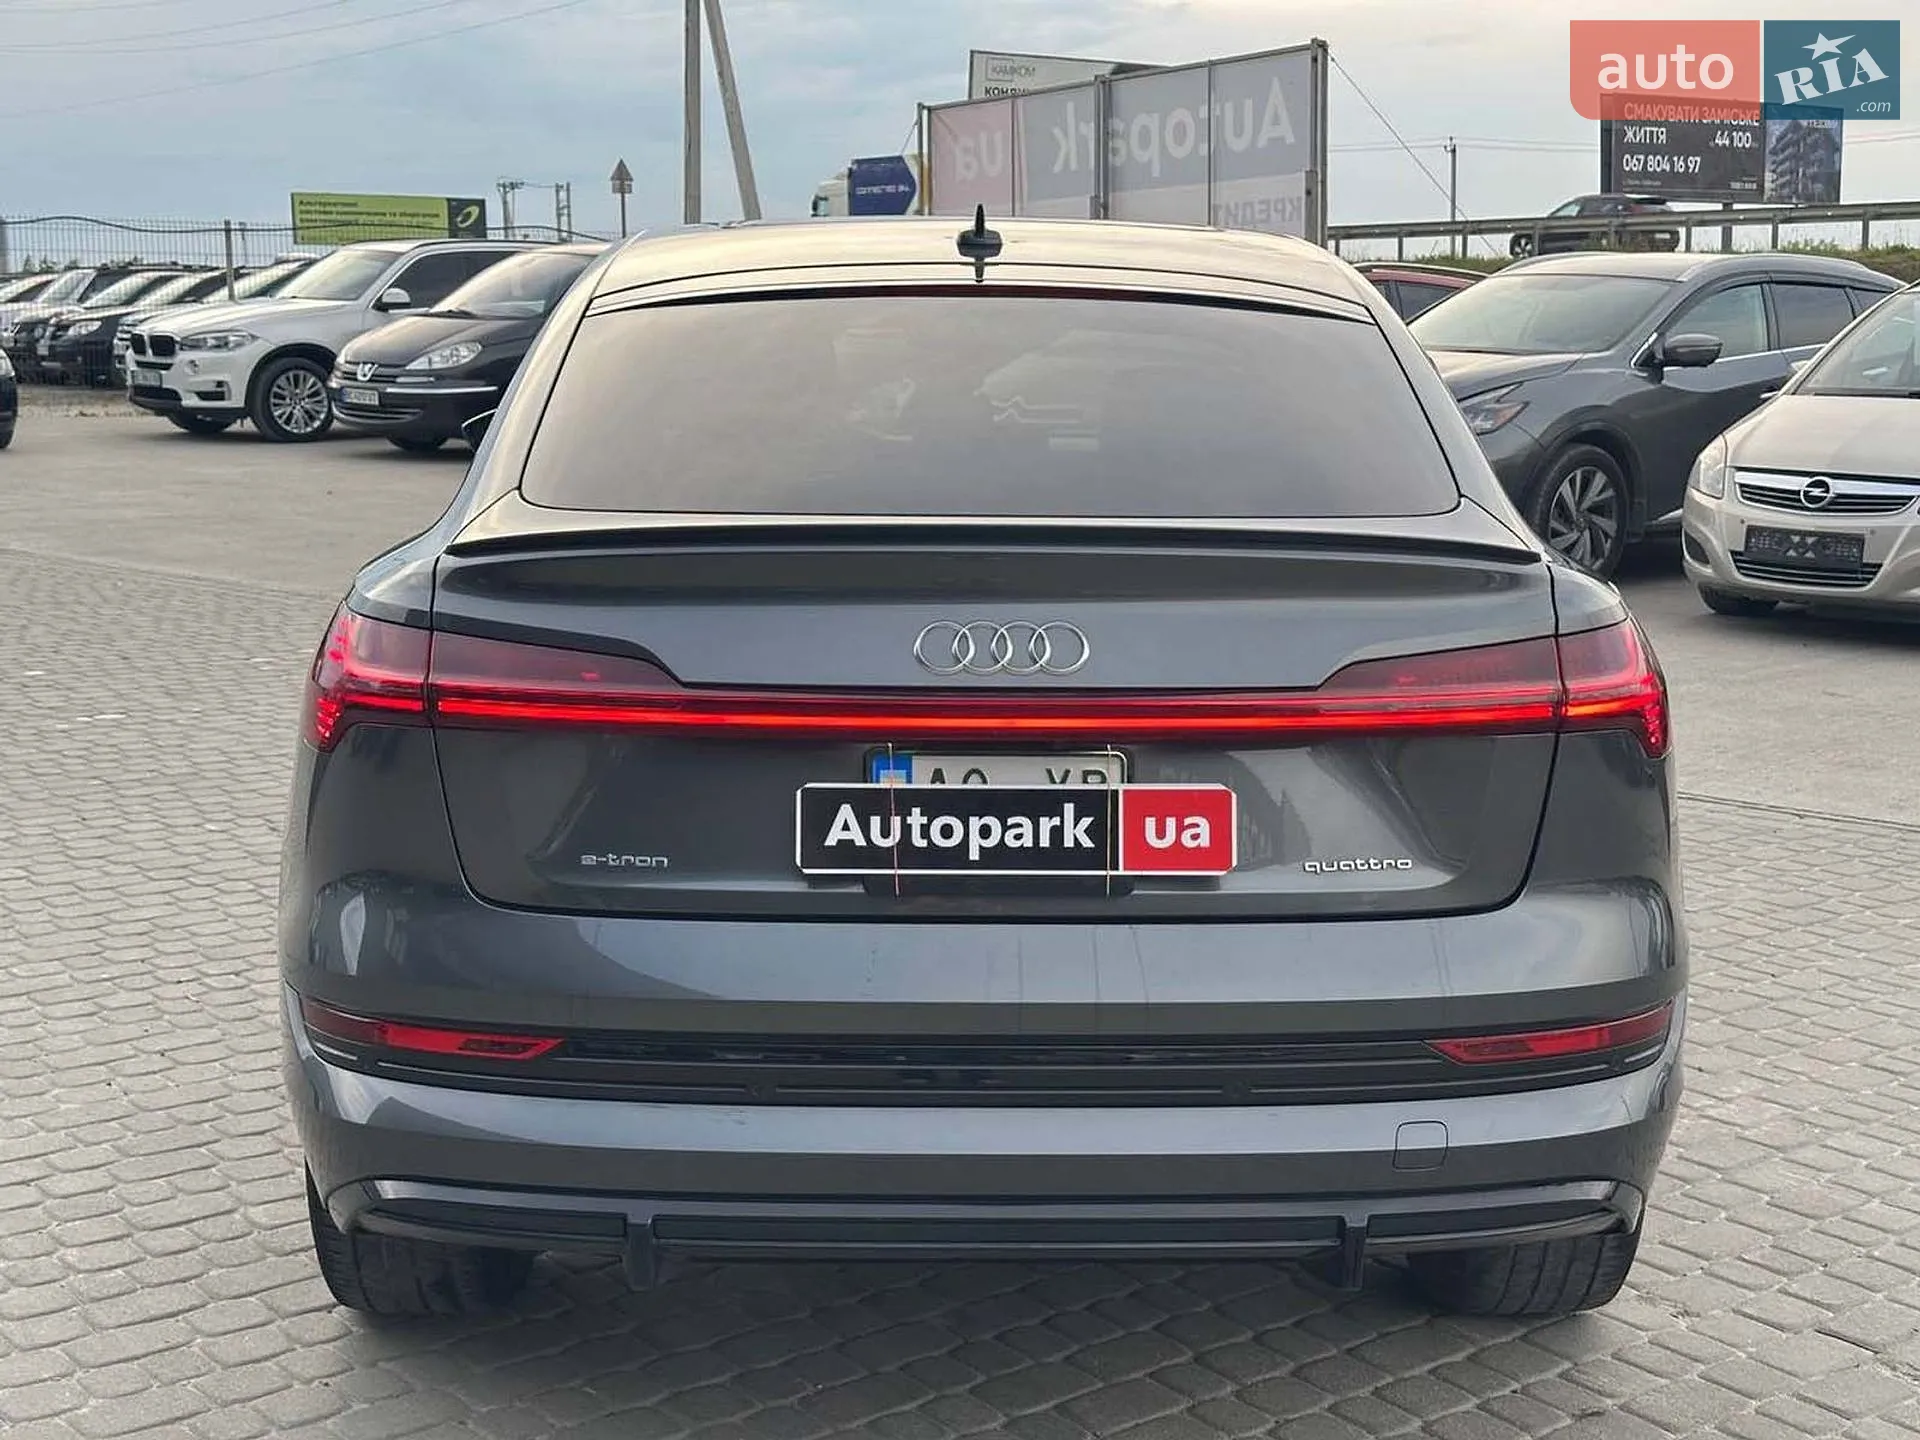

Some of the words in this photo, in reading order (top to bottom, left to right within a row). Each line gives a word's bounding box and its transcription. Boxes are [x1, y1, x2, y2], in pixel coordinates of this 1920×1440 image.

[1623, 103, 1699, 125] СМАКУВАТИ
[1623, 126, 1667, 145] ЖИТТЯ
[1714, 130, 1730, 147] 44
[1731, 132, 1752, 149] 100
[1622, 154, 1644, 173] 067
[1647, 155, 1671, 173] 804
[1673, 156, 1685, 173] 16
[1687, 156, 1701, 173] 97
[823, 803, 1096, 861] Autopark
[1144, 815, 1211, 849] ua
[580, 853, 668, 868] e-tron
[1303, 858, 1413, 874] quattro
